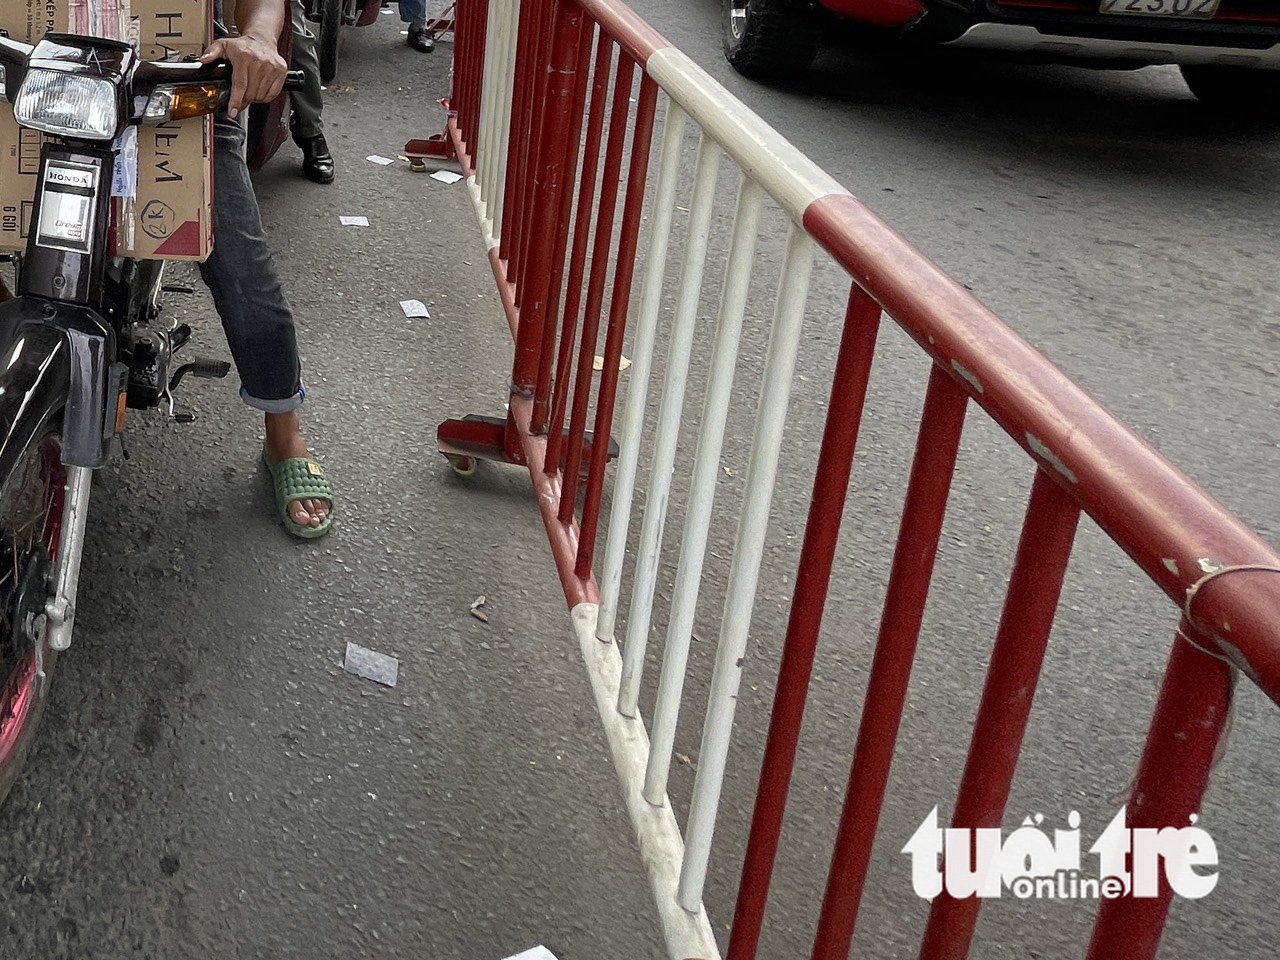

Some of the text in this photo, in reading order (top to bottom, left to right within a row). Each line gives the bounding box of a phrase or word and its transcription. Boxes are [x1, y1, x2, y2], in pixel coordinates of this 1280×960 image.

[49, 172, 88, 184] HONDA
[2, 215, 19, 232] GÓI
[55, 220, 83, 230] Dream
